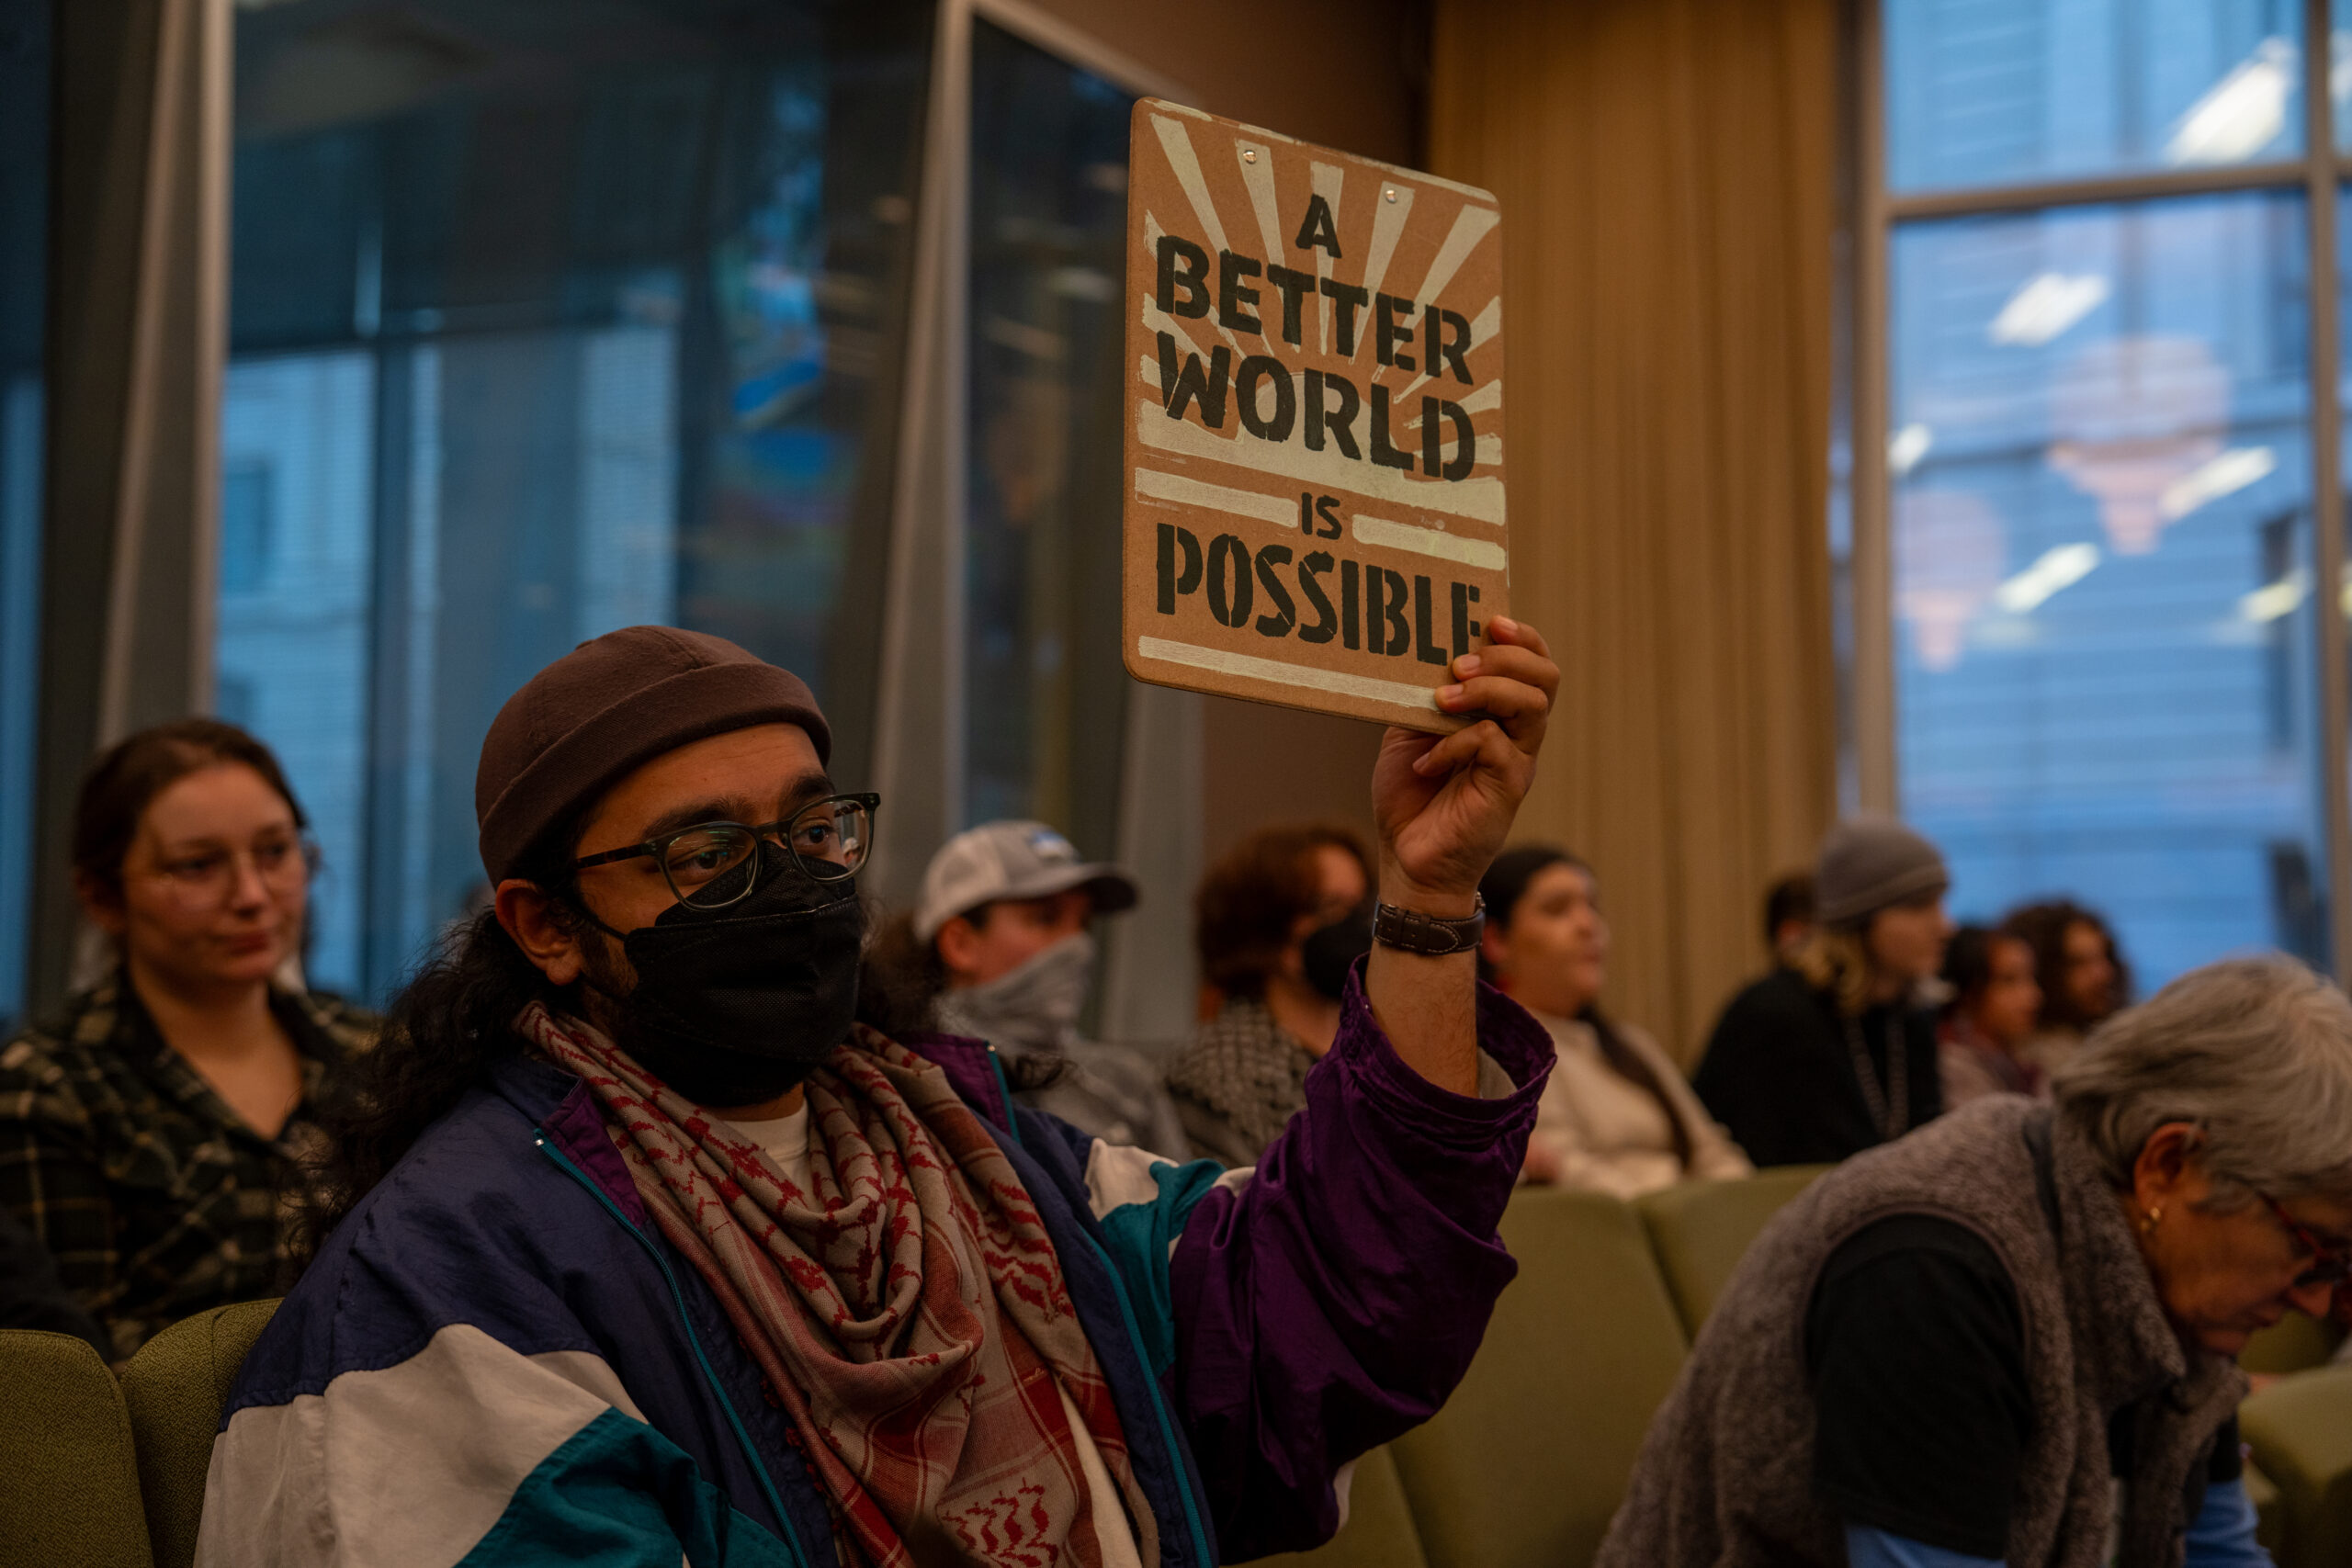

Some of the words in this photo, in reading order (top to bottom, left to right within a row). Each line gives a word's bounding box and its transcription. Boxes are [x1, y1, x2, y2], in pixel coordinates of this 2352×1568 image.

[1296, 194, 1341, 259] A
[1156, 235, 1475, 385] BETTER
[1156, 330, 1476, 482] WORLD
[1300, 491, 1342, 539] IS
[1156, 522, 1481, 666] POSSIBLE
